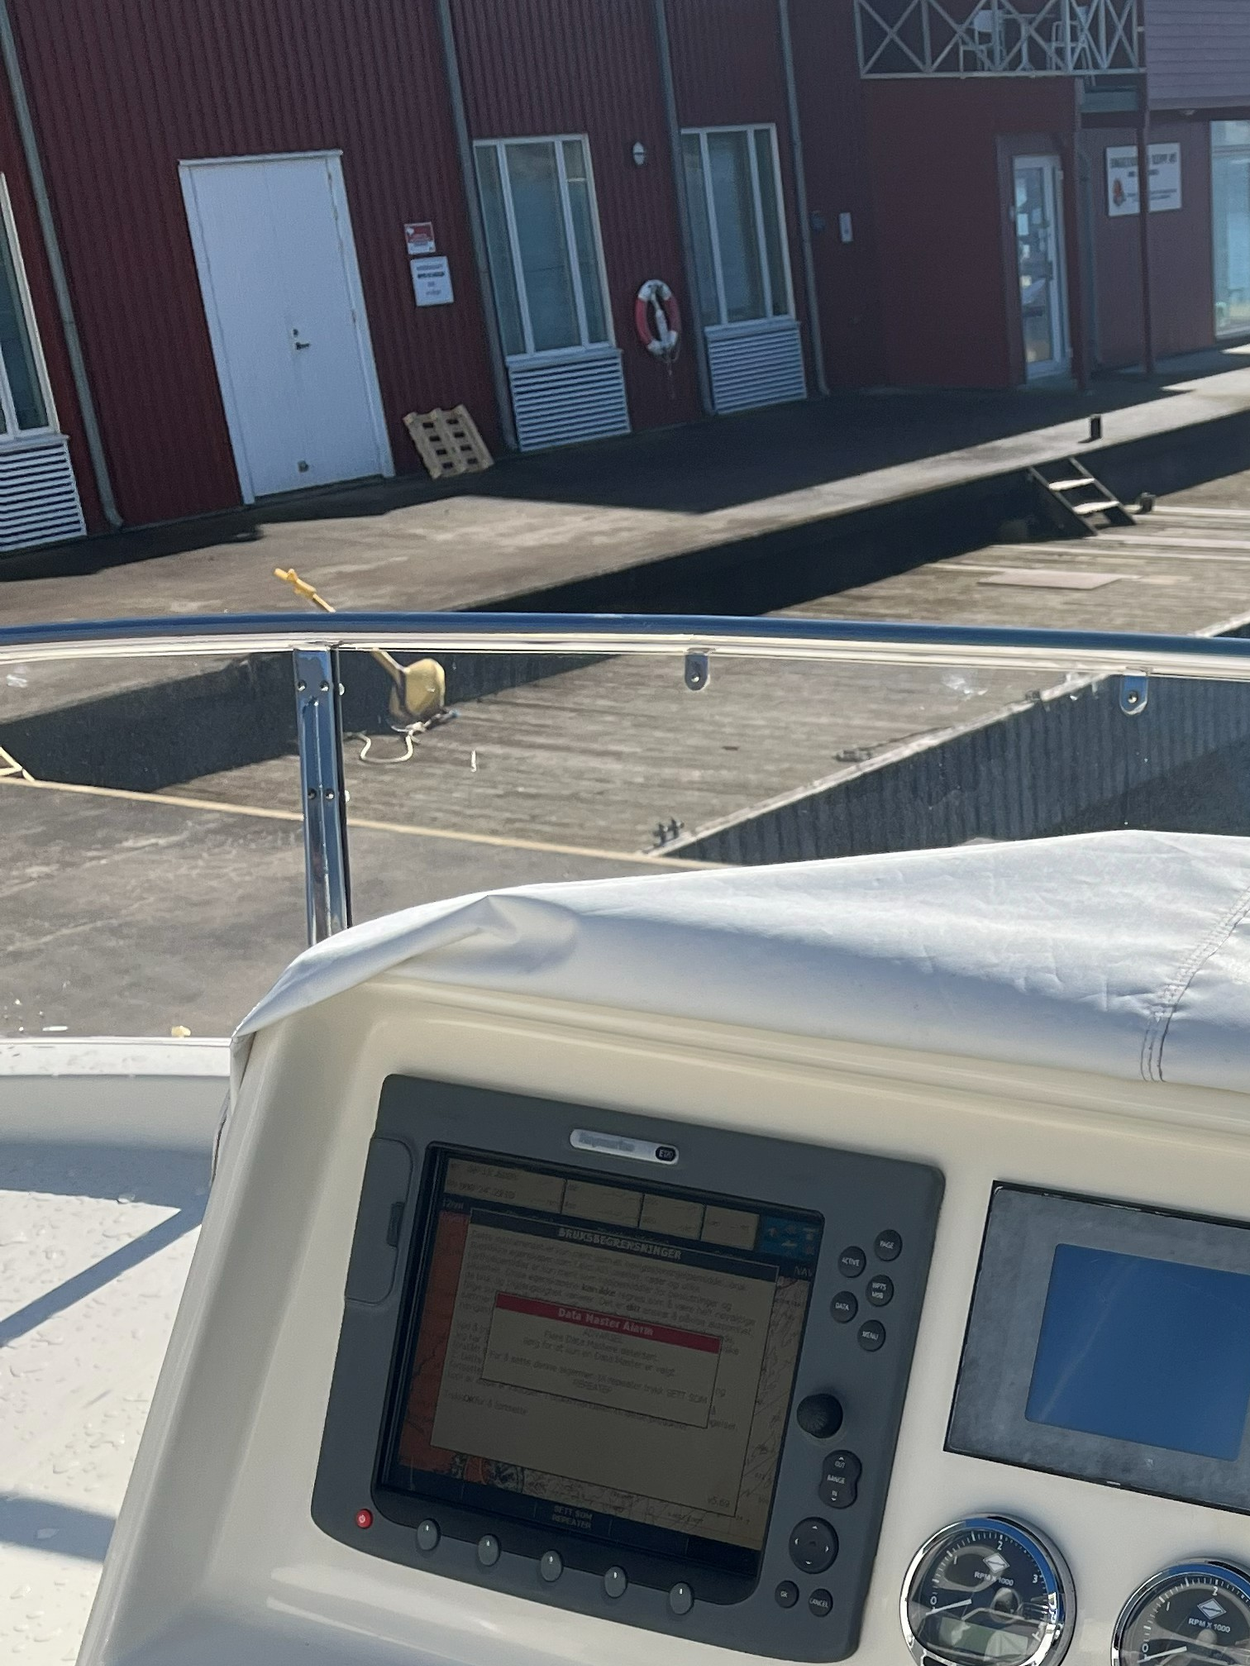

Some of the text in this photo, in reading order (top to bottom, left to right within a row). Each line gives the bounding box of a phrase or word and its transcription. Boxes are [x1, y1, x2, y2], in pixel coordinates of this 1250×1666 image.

[558, 1307, 582, 1320] Data
[585, 1313, 619, 1328] Master
[622, 1320, 653, 1335] Alarm
[997, 1541, 1002, 1550] 2
[1033, 1574, 1038, 1583] 3
[1212, 1586, 1218, 1596] 2
[930, 1596, 937, 1605] 0
[1188, 1618, 1206, 1627] RPM
[1214, 1621, 1230, 1633] 1000
[1142, 1643, 1148, 1652] 0
